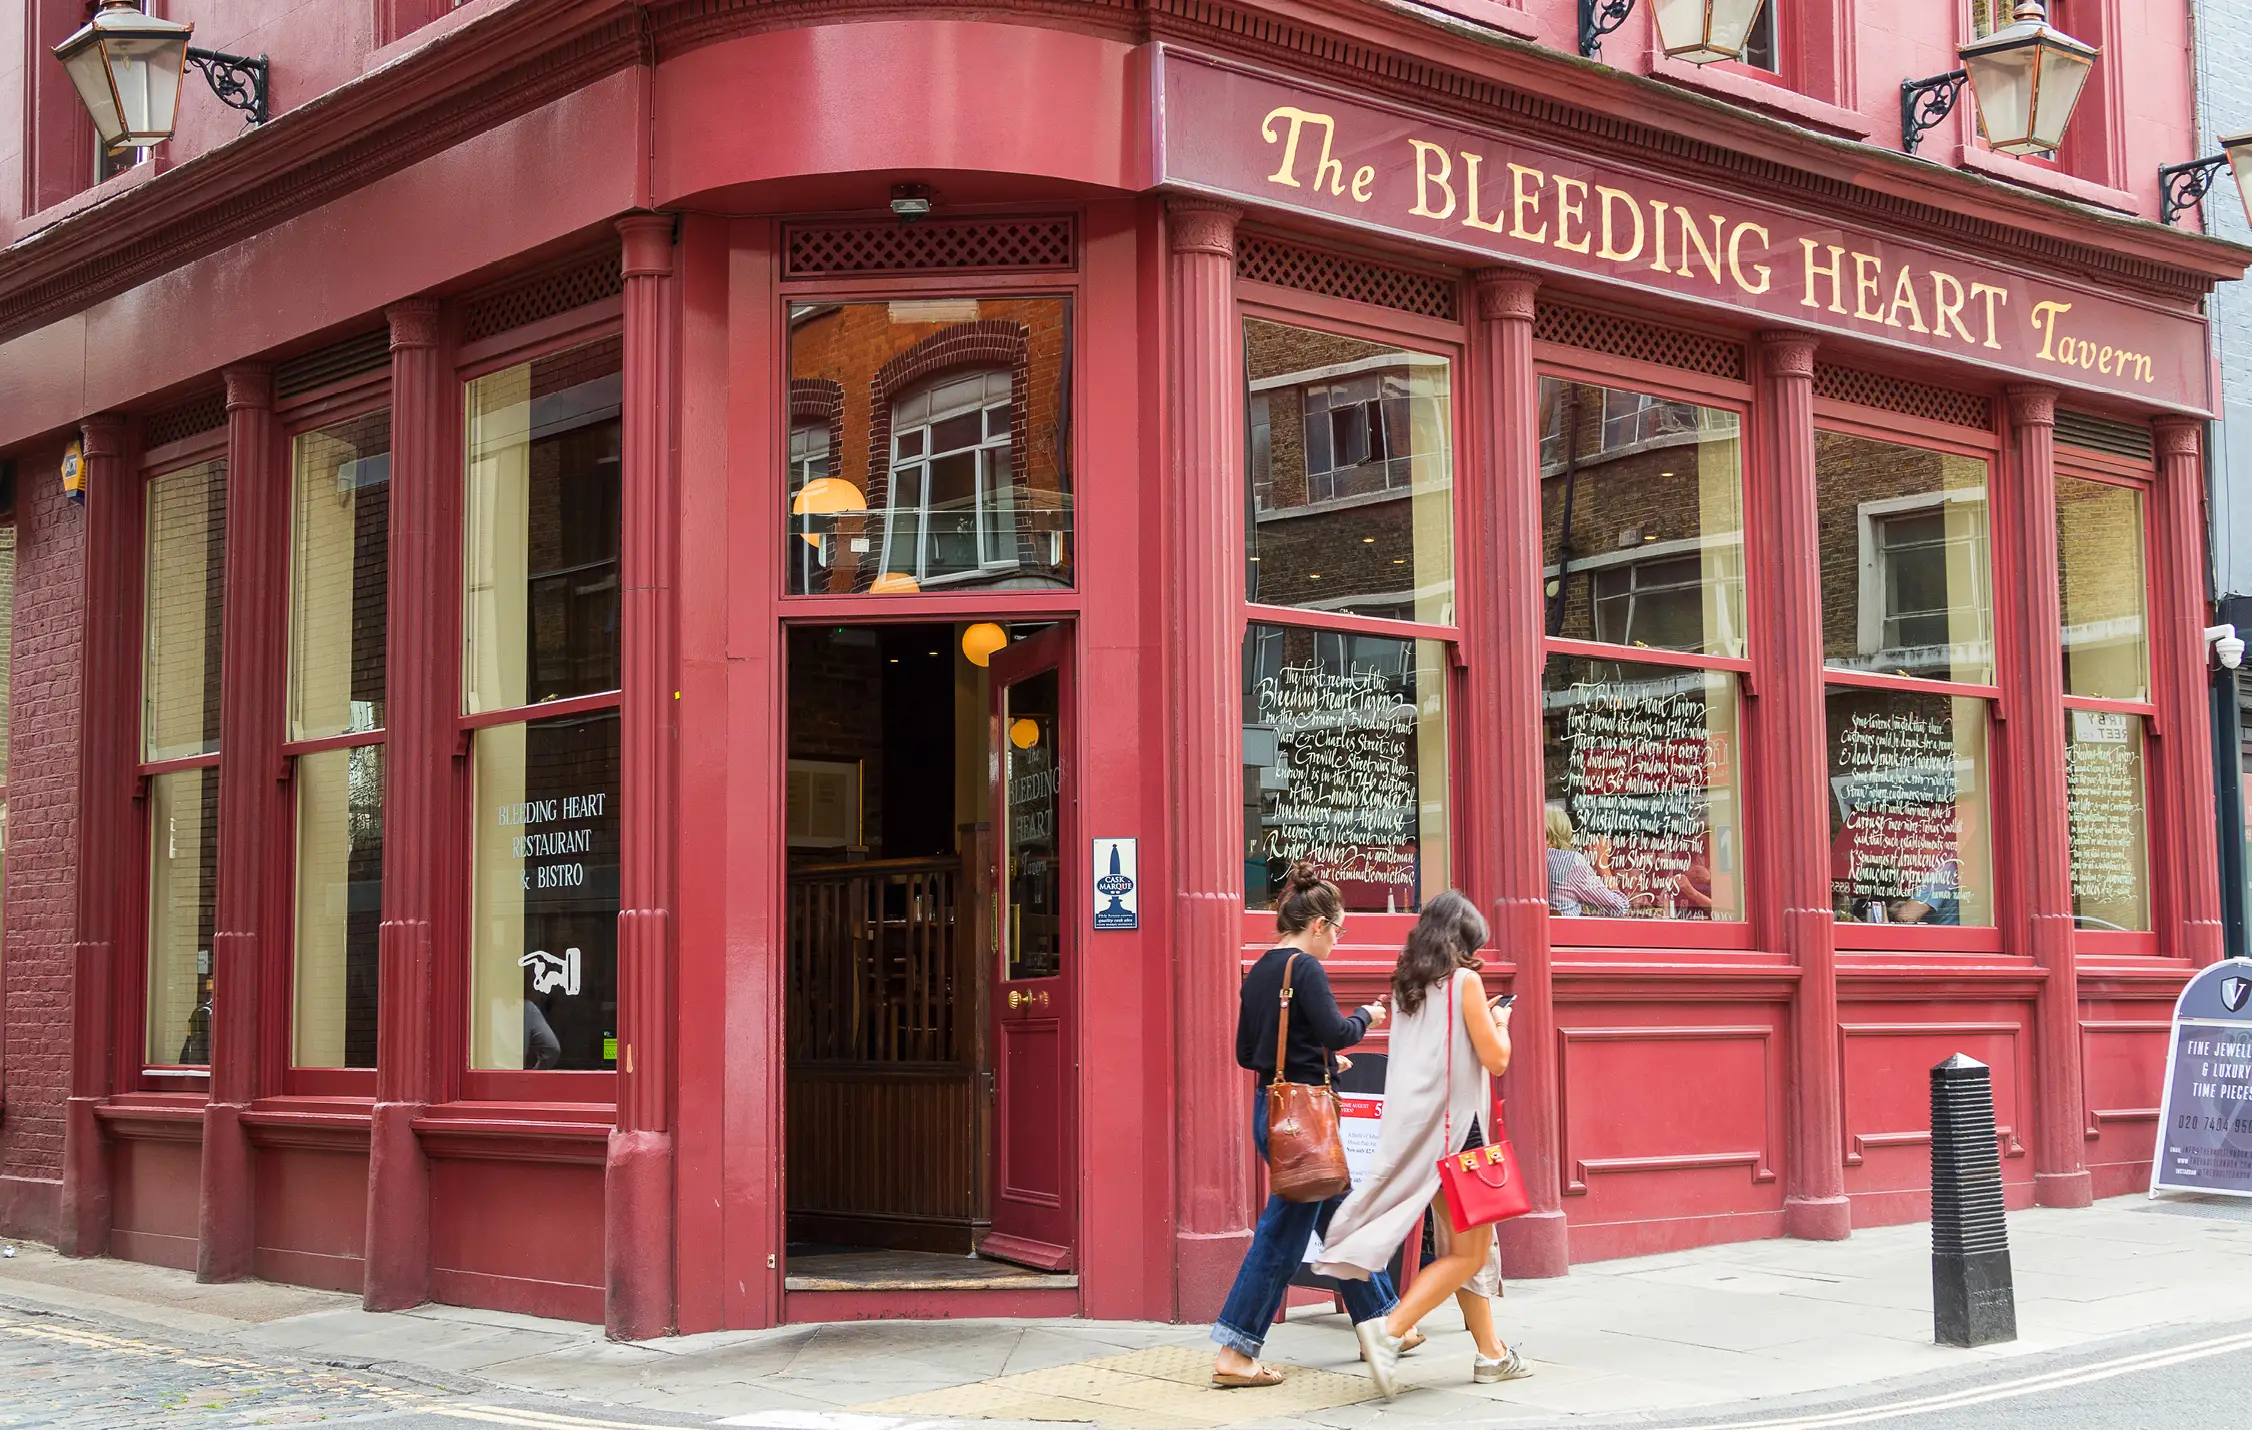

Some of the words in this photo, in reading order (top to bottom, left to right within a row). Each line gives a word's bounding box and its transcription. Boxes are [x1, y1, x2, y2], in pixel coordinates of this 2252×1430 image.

[1261, 106, 1376, 203] The
[1407, 138, 1772, 294] BLEEDING
[1798, 237, 2008, 349] HEART
[2031, 300, 2154, 383] Tavern
[1301, 659, 1326, 690] first
[1254, 677, 1318, 712] Bleeding
[1319, 687, 1357, 713] Heart
[1359, 690, 1404, 714] Tavern
[1592, 683, 1638, 714] Bleeding
[1638, 687, 1669, 717] Heart
[1670, 693, 1706, 721] Tavern
[1348, 711, 1391, 737] Bleeding
[1390, 715, 1420, 735] Heart
[1567, 707, 1590, 735] first
[1590, 711, 1617, 735] opened
[1665, 718, 1689, 740] 1746
[1315, 726, 1356, 751] Charles
[1663, 738, 1678, 762] for
[1275, 750, 1310, 781] known)
[1311, 767, 1320, 784] is
[1321, 768, 1333, 782] in
[1332, 768, 1346, 786] the
[1379, 776, 1410, 792] edition
[1344, 753, 1376, 774] Street
[1008, 766, 1060, 806] BLEEDING
[1315, 782, 1360, 806] London
[1359, 787, 1403, 809] Register
[498, 800, 557, 826] BLEEDING
[563, 793, 606, 819] HEART
[1334, 805, 1354, 827] and
[1016, 809, 1052, 842] HEART
[512, 829, 592, 858] RESTAURANT
[1263, 830, 1308, 864] Roger
[1374, 846, 1415, 865] gentleman
[519, 868, 531, 890] &
[537, 862, 584, 889] BISTRO
[1021, 850, 1047, 876] Tavern
[2228, 984, 2246, 1004] V
[2188, 1041, 2210, 1056] FINE
[2214, 1042, 2252, 1058] JEWELL
[2202, 1062, 2209, 1077] &
[2213, 1063, 2252, 1079] LUXURY
[2193, 1082, 2216, 1098] TIME
[2220, 1084, 2252, 1101] PIECES
[2178, 1115, 2198, 1129] 020
[2204, 1117, 2228, 1132] 7404
